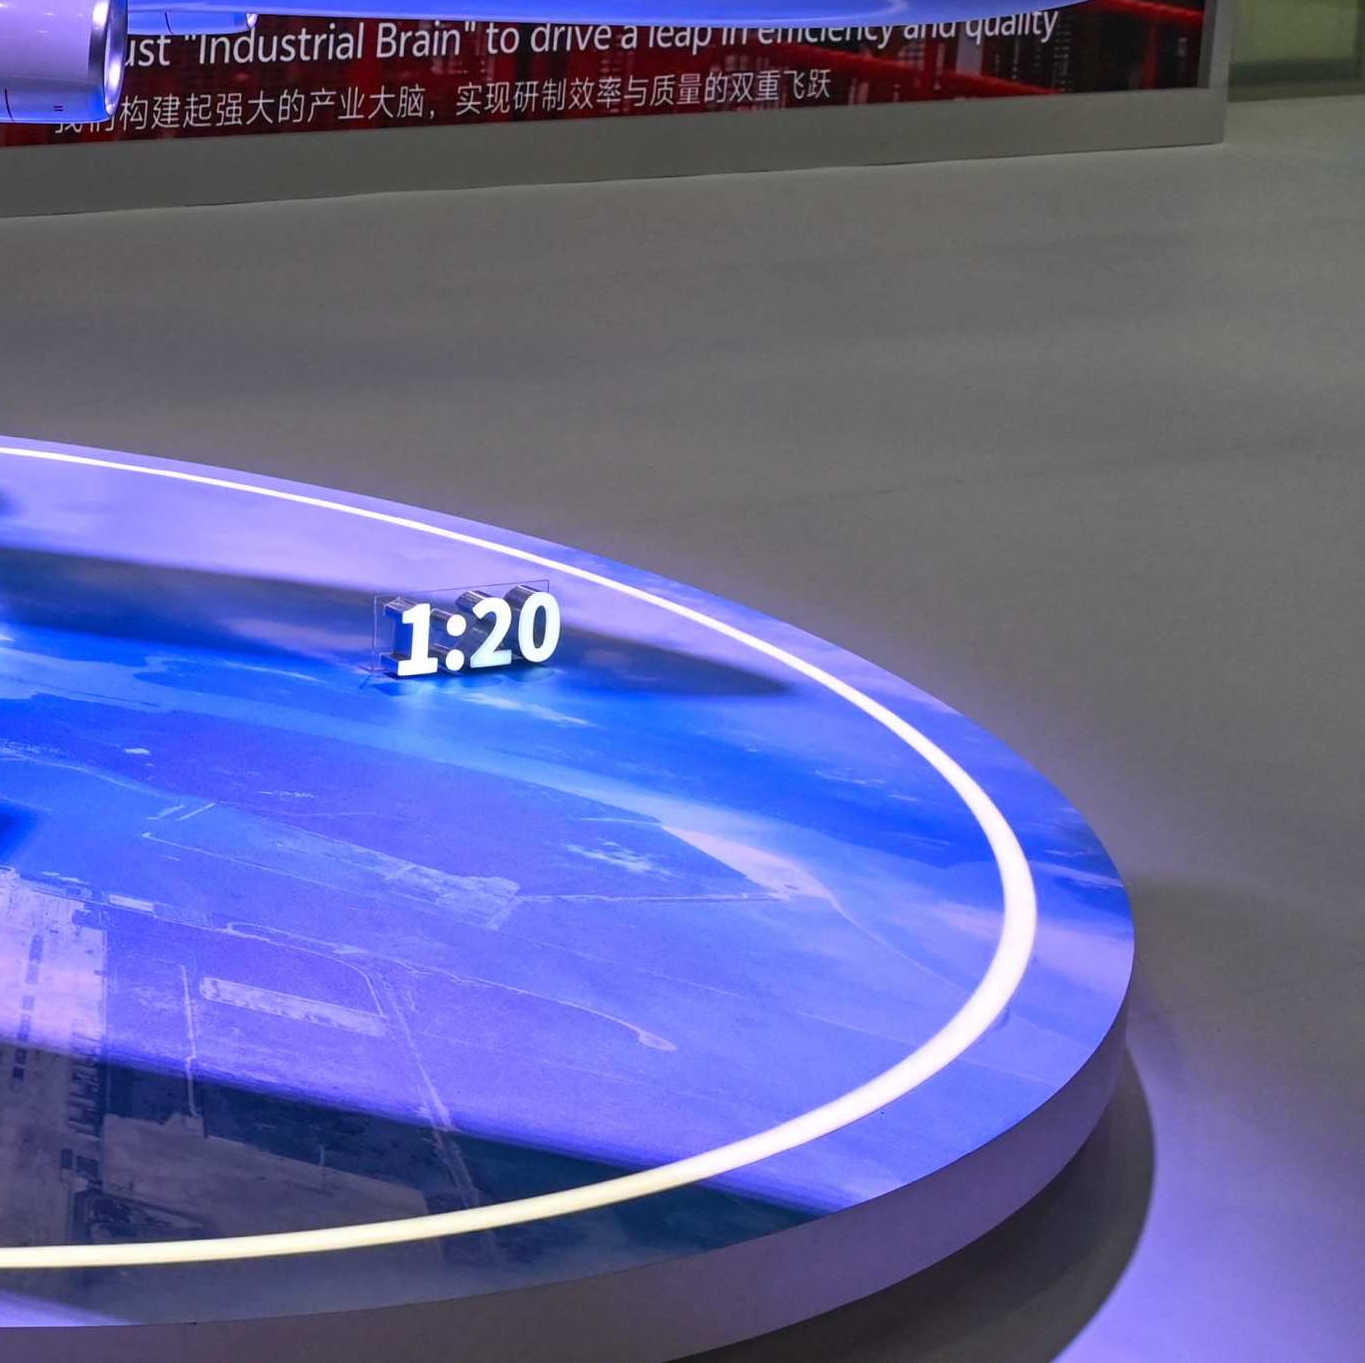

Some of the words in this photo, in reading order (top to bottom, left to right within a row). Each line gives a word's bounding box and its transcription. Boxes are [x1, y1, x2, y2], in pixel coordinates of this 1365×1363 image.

[376, 20, 476, 59] Brain"
[486, 23, 520, 55] to
[530, 23, 612, 53] drive
[620, 25, 638, 50] a
[648, 25, 712, 56] leap
[397, 591, 561, 677] 1:20
